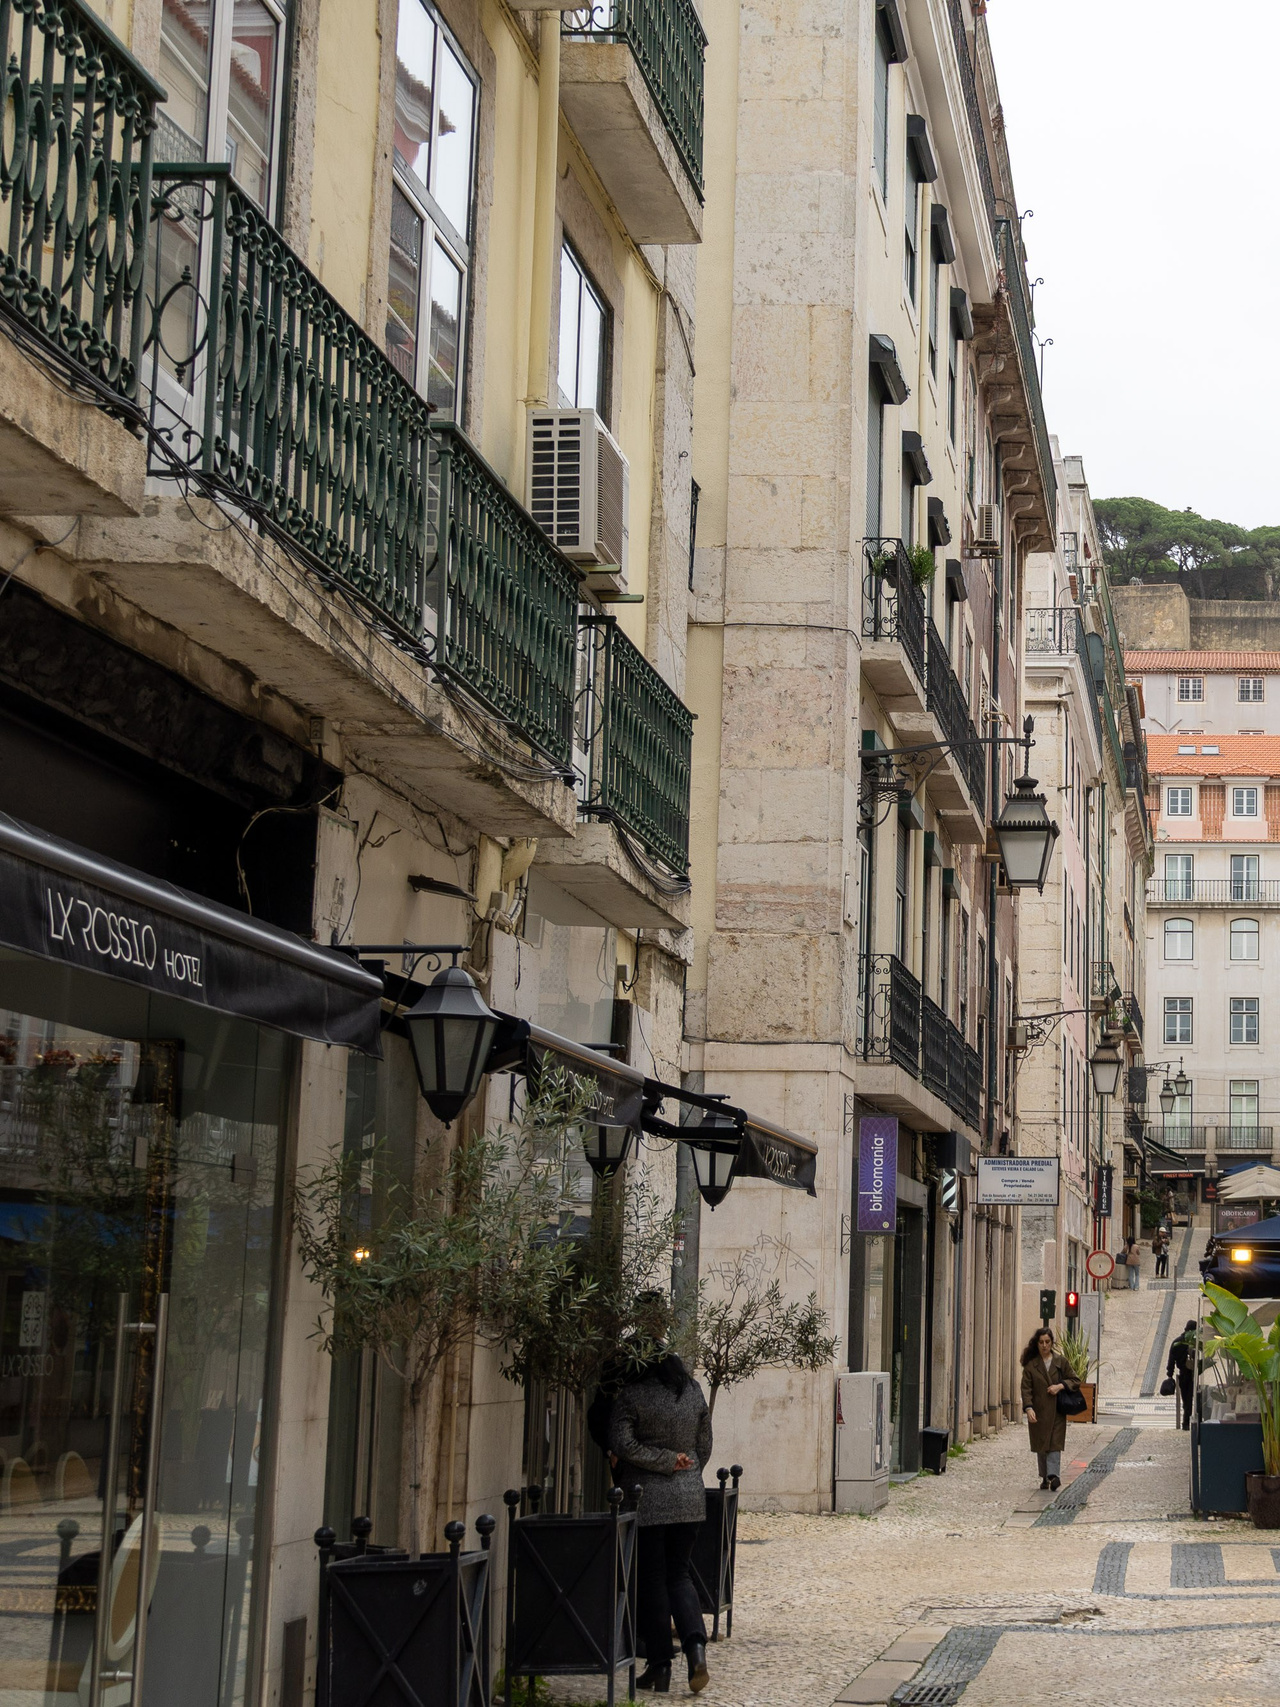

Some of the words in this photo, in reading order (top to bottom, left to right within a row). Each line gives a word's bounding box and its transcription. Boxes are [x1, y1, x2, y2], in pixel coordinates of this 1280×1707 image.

[47, 887, 75, 946] LX
[76, 899, 157, 971] ROSSIO
[164, 948, 203, 988] HOTEL
[860, 1136, 885, 1212] birkomania
[2, 1354, 16, 1377] LX
[16, 1354, 54, 1377] ROSSIO
